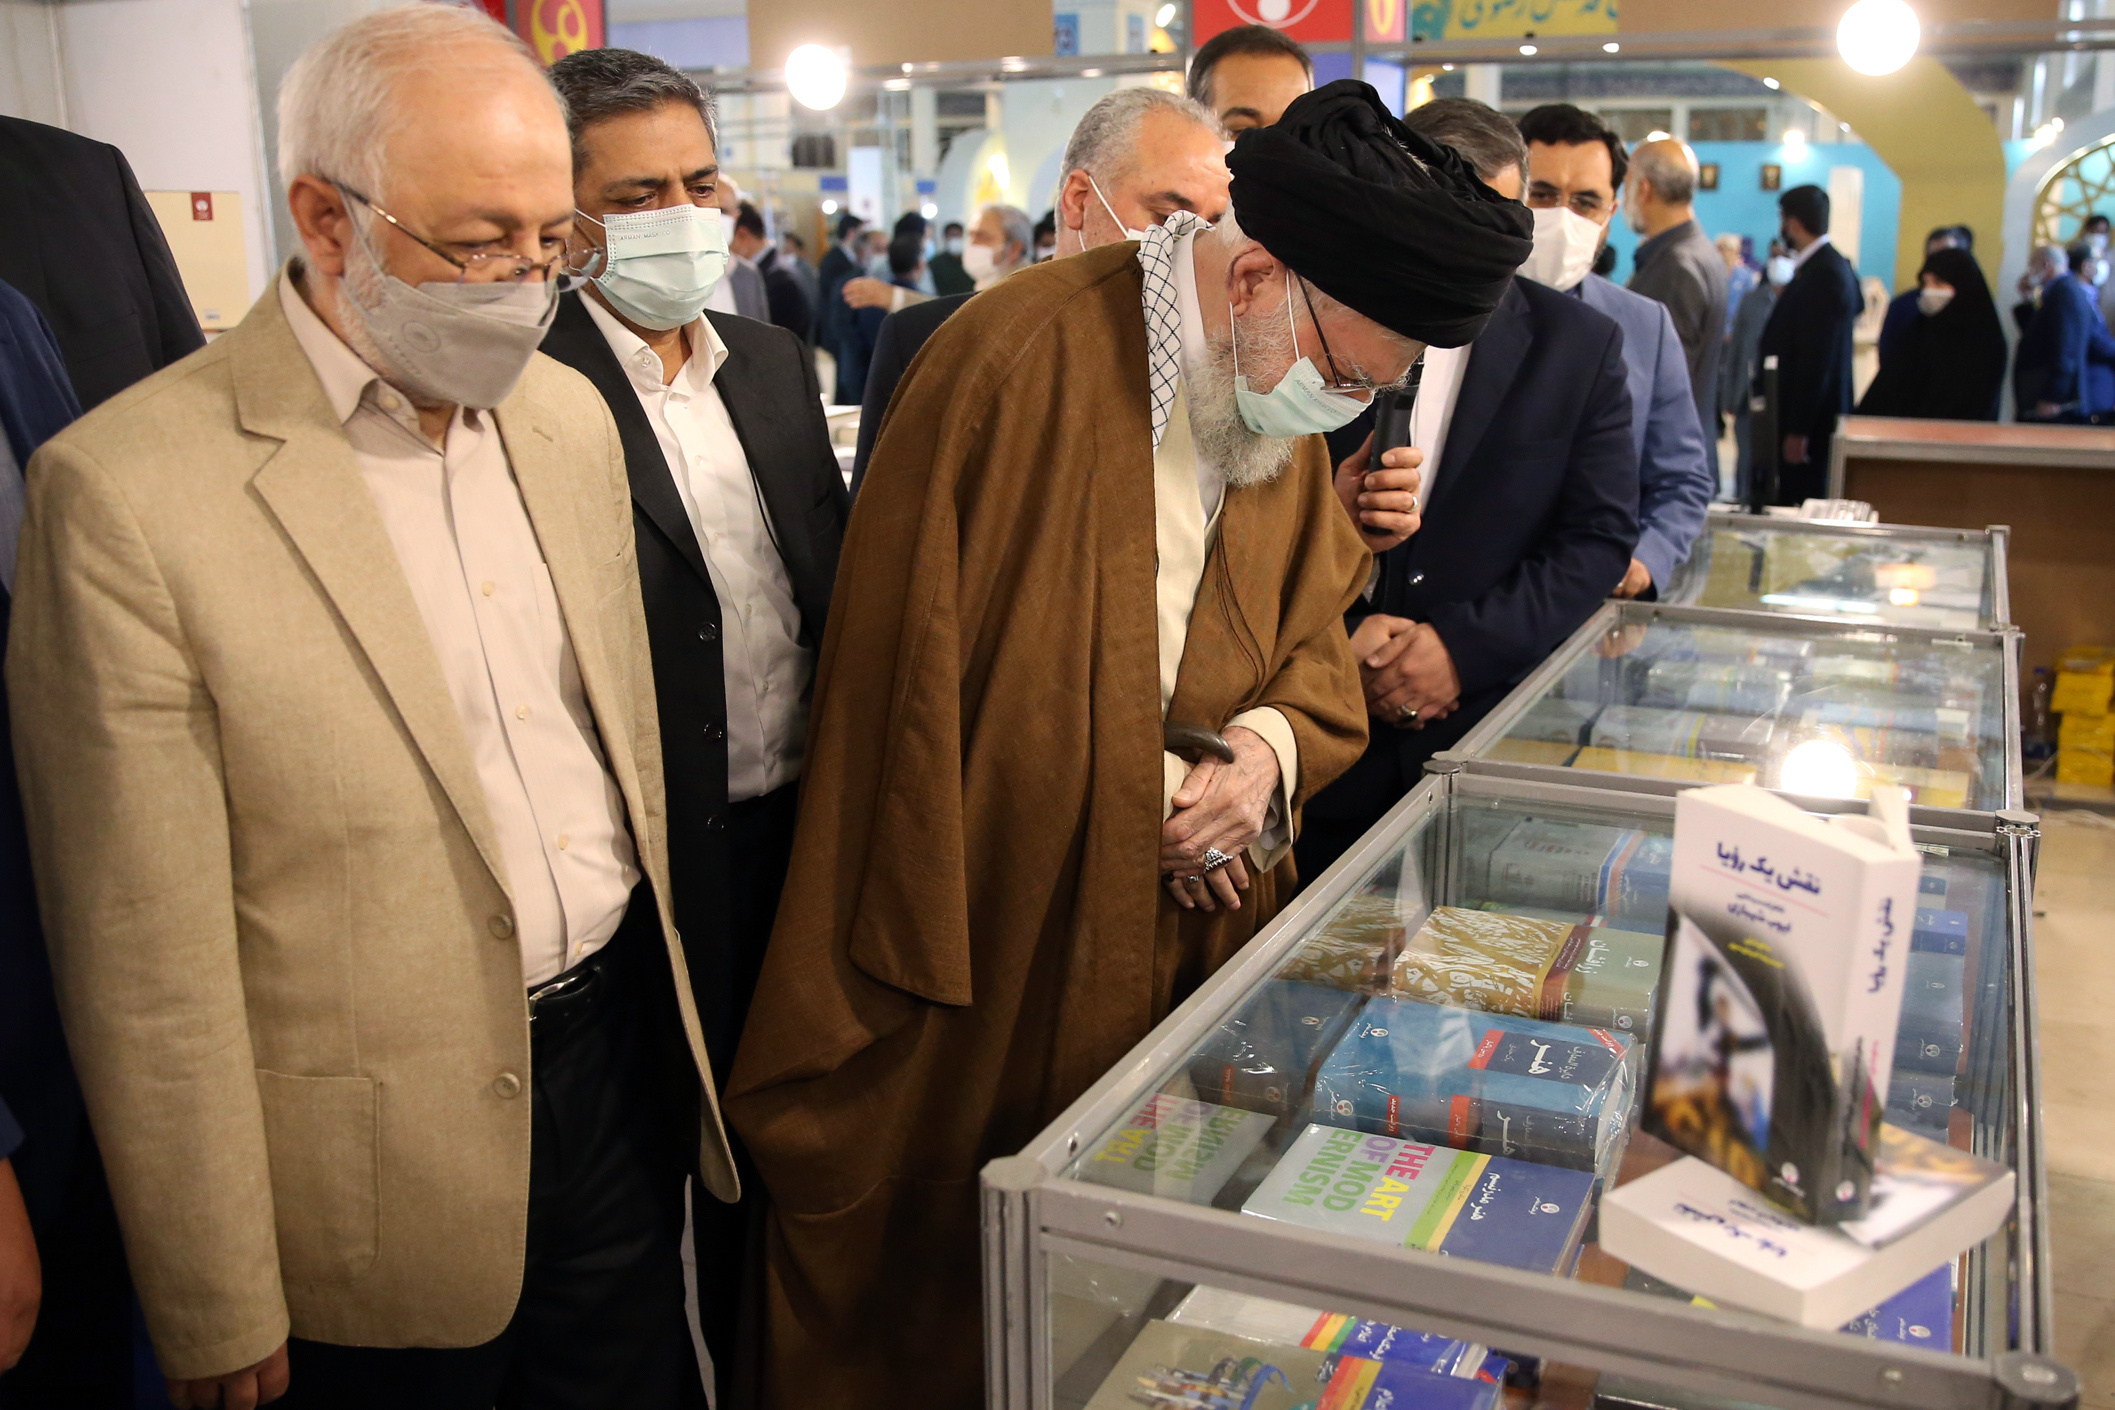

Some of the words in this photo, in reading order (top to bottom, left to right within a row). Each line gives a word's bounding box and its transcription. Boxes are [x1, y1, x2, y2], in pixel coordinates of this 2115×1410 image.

[1749, 857, 1774, 883] یک
[1776, 866, 1821, 894] نقش
[1528, 1038, 1553, 1075] هنر
[1282, 1129, 1365, 1206] ERNISM
[1360, 1136, 1397, 1164] OF
[1385, 1144, 1436, 1180] THE
[1322, 1160, 1381, 1211] MOD
[1359, 1176, 1410, 1222] ART
[1470, 1202, 1486, 1220] هنر
[1479, 1172, 1501, 1204] مدرنیسم
